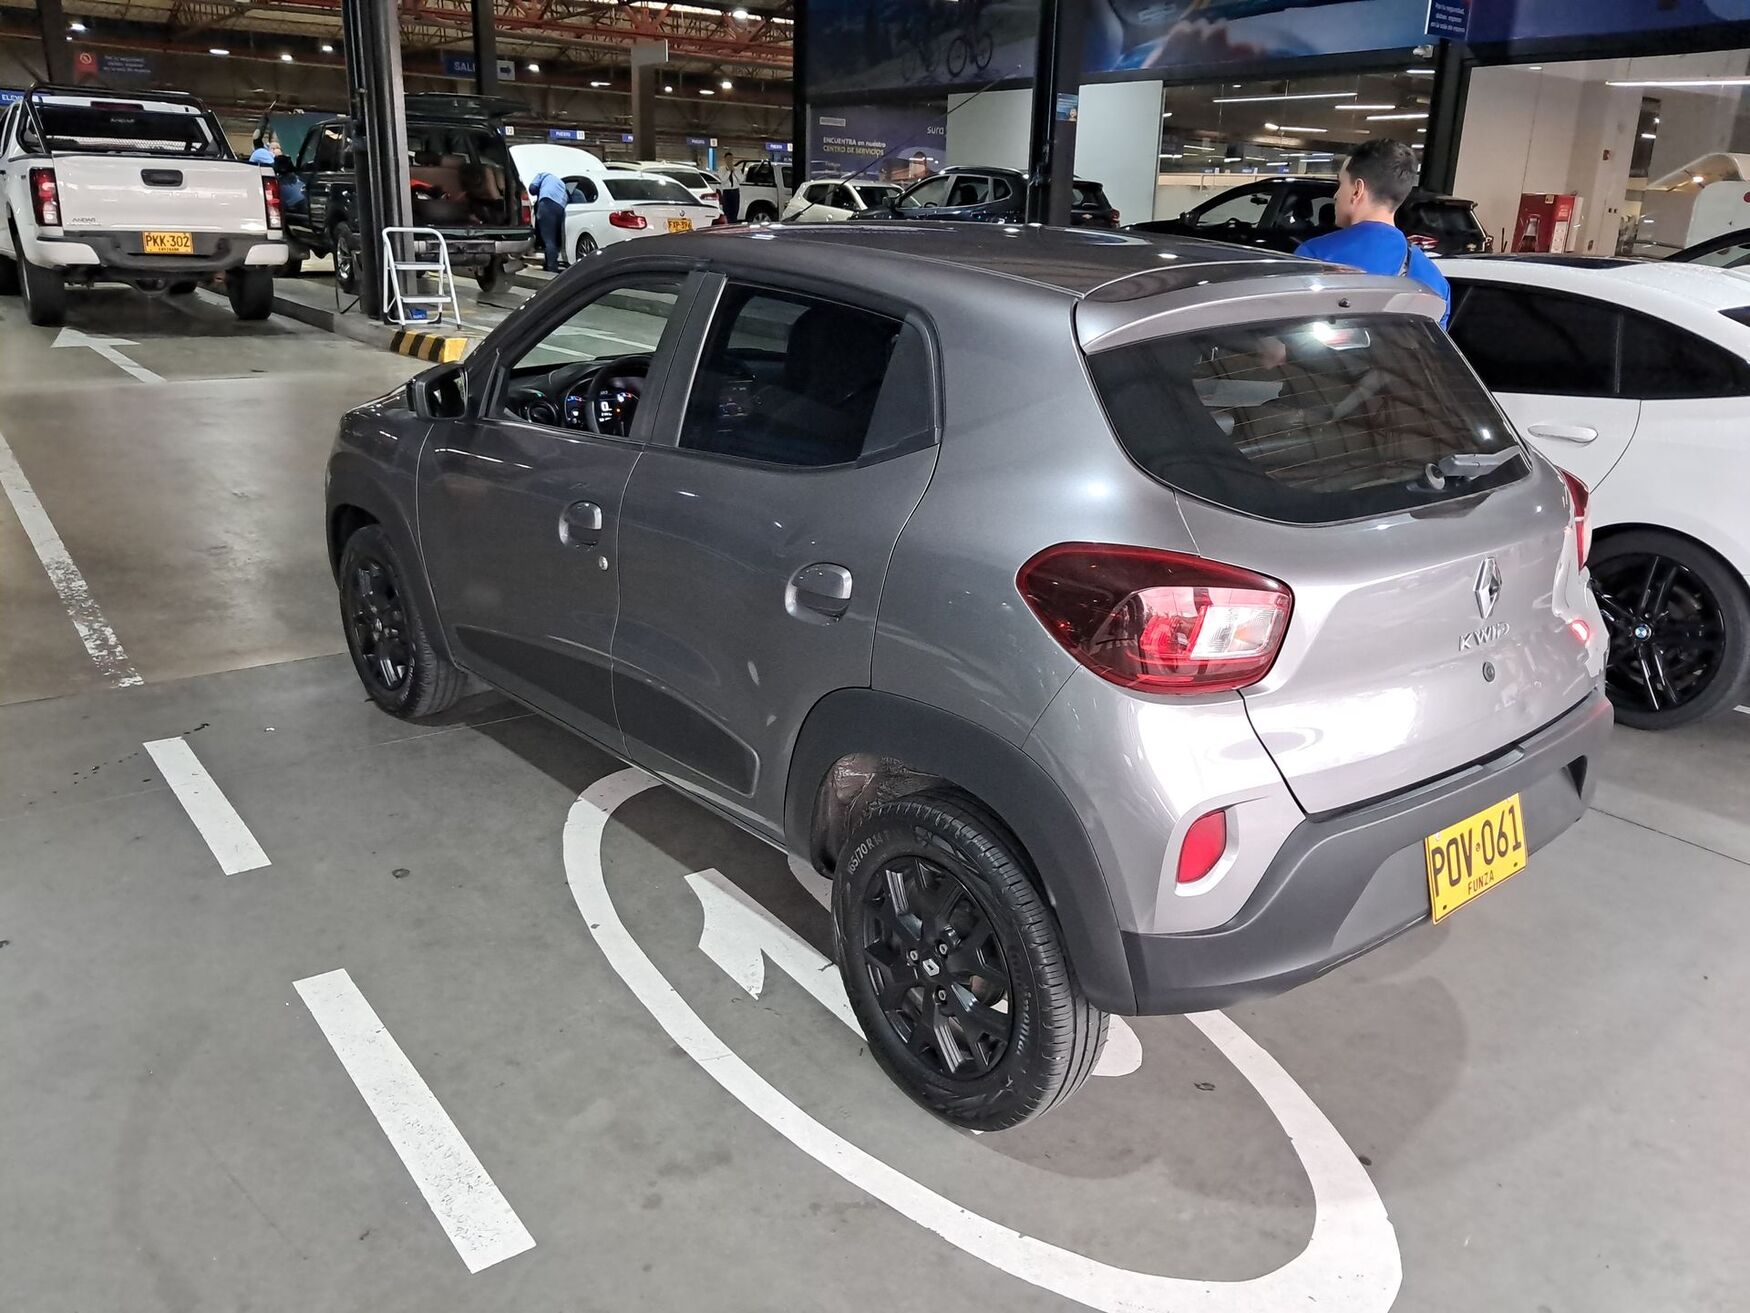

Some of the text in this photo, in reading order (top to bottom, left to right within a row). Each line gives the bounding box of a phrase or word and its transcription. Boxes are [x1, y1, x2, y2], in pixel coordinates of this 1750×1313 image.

[927, 126, 944, 135] sura
[823, 136, 857, 146] ENCUENTRA
[1458, 622, 1510, 652] KWID
[1467, 869, 1495, 896] FUNZA
